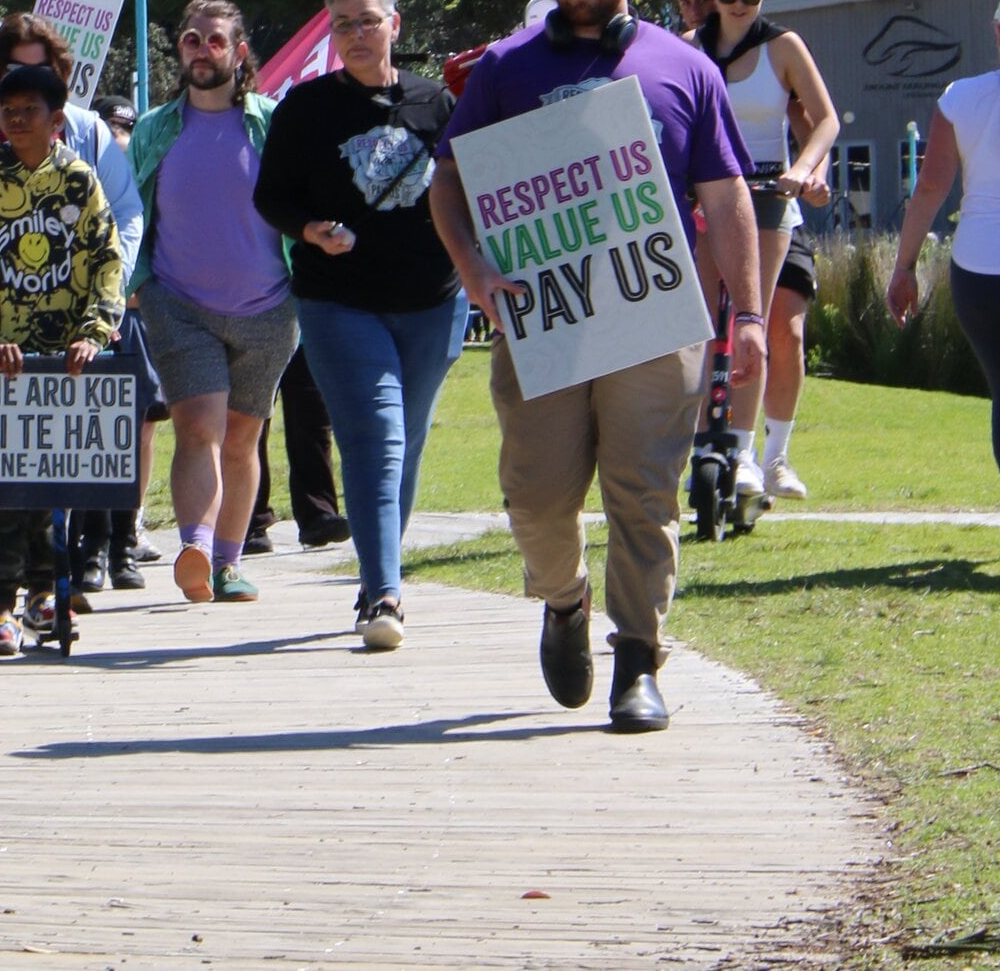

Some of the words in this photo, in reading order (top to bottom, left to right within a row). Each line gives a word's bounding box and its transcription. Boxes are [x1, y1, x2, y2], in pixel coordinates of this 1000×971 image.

[94, 9, 113, 31] US
[81, 31, 104, 59] US
[477, 155, 604, 229] RESPECT
[609, 140, 652, 182] US
[486, 199, 607, 275] VALUE
[610, 181, 665, 233] US
[502, 254, 595, 340] PAY
[608, 231, 683, 303] US
[25, 376, 77, 408] ARO
[85, 377, 133, 408] KOE
[17, 414, 53, 450] TE
[64, 408, 105, 451] HĀ
[114, 414, 132, 450] O
